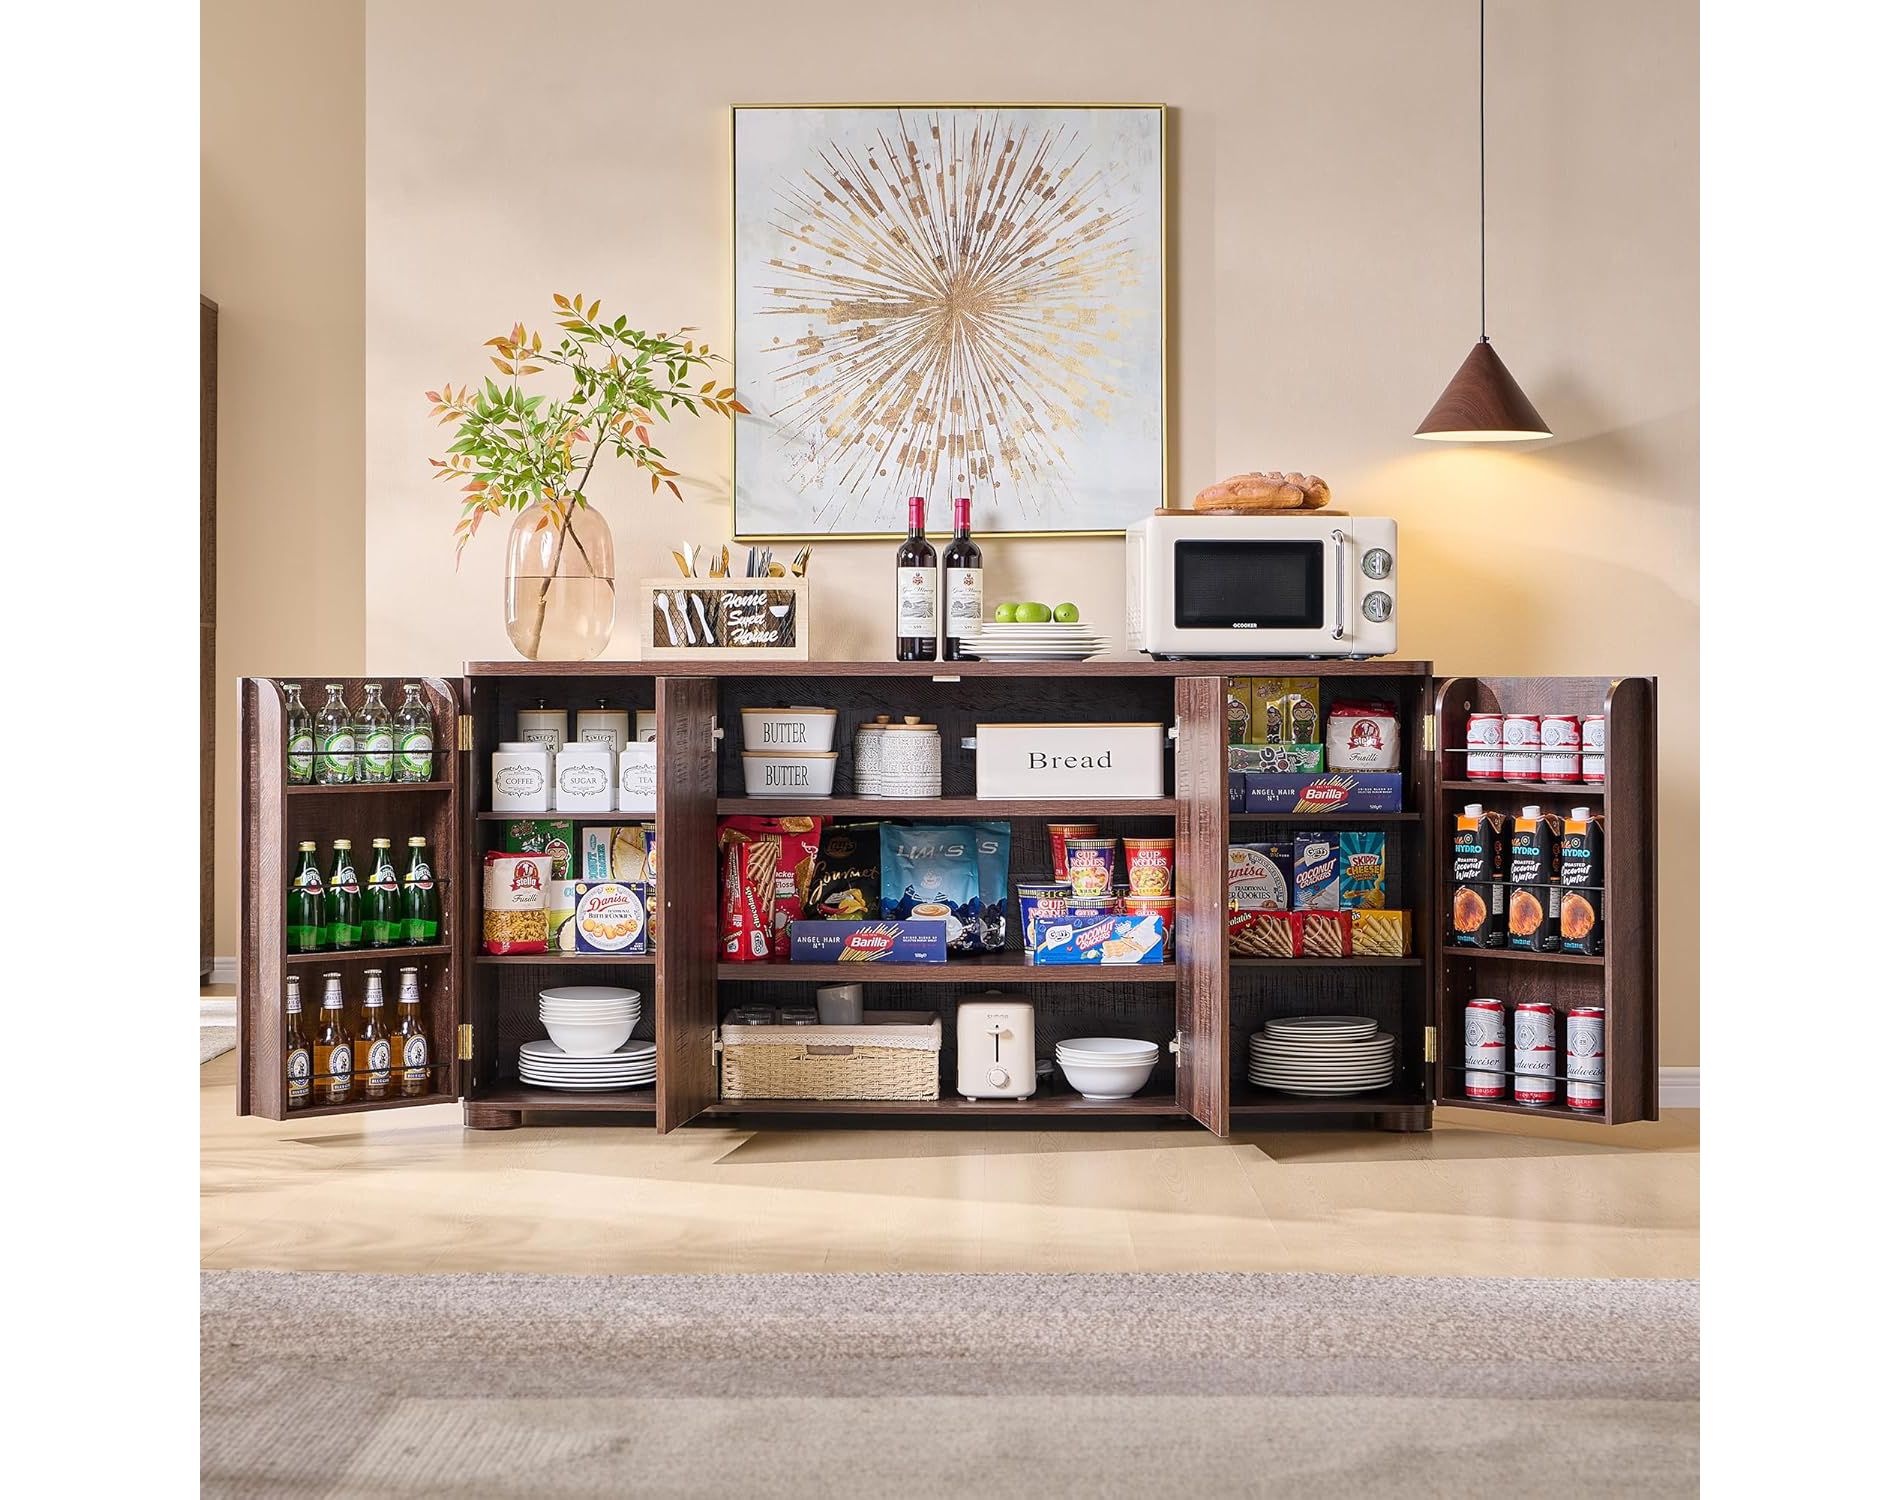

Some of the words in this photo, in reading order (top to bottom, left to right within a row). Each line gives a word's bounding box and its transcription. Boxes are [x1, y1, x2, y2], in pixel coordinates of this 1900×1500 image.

[720, 592, 768, 609] Home
[727, 610, 766, 628] Sweet
[731, 629, 778, 645] Home
[763, 722, 807, 743] BUTTER
[1028, 750, 1112, 769] Bread
[570, 777, 598, 785] SUGAR
[639, 776, 653, 784] TEA
[765, 765, 809, 786] BUTTER
[1305, 788, 1344, 800] Barilla
[1075, 850, 1099, 859] CUP
[1138, 850, 1161, 859] CUP
[1455, 844, 1482, 854] HYDRO
[1511, 846, 1540, 856] HYDRO
[1562, 848, 1591, 858] HYDRO
[1071, 858, 1105, 867] NOODLES
[1132, 858, 1167, 867] NOODLES
[1228, 863, 1265, 879] anisa
[1296, 858, 1337, 884] COCONUT
[1346, 865, 1381, 876] CHEESE
[1455, 870, 1481, 881] Water
[809, 861, 879, 905] Gourmet
[1300, 870, 1332, 889] CRACKERS
[1512, 872, 1538, 883] Water
[1563, 875, 1589, 886] Water
[1038, 890, 1067, 898] BIG
[1237, 891, 1271, 899] COOKIES
[587, 893, 630, 912] Danisa
[1038, 899, 1065, 910] CUP
[1076, 919, 1116, 946] COCONUT
[851, 937, 890, 948] Barilla
[1515, 1058, 1551, 1070] dweiser
